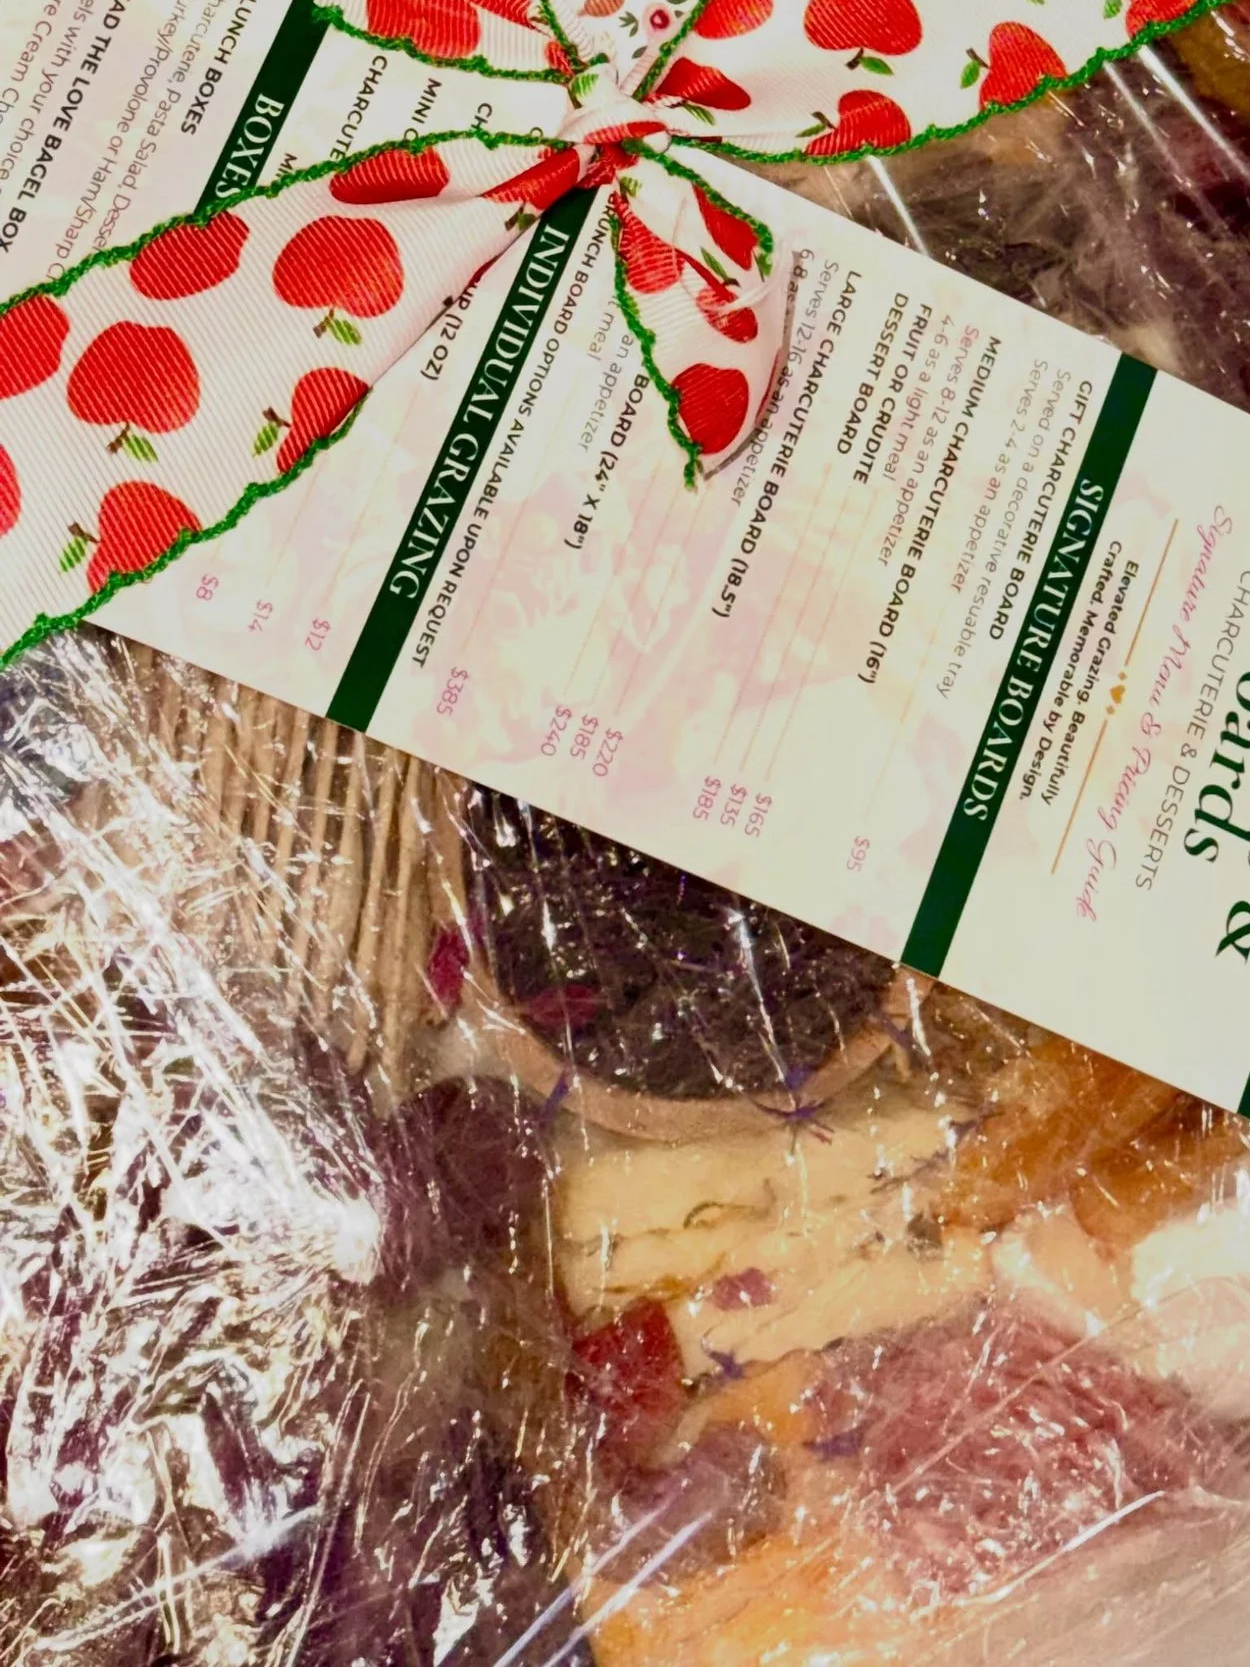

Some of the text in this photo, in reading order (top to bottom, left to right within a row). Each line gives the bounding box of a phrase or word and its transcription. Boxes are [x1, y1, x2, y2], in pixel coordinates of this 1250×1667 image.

[11, 20, 52, 82] Cream
[50, 26, 80, 67] with
[80, 35, 111, 74] THE
[29, 68, 58, 114] your
[52, 76, 90, 131] LOVE
[146, 87, 181, 137] Pasta
[180, 67, 222, 134] BOXES
[327, 52, 389, 163] CHARCUTE
[411, 77, 442, 124] MINI
[0, 117, 35, 178] choice
[17, 133, 62, 199] BAGEL
[105, 133, 124, 157] or
[117, 138, 157, 190] Salad,
[216, 93, 283, 208] BOXES
[0, 206, 27, 253] BOX
[55, 156, 116, 259] Ham/Sharp
[419, 278, 478, 380] UP (12 OZ)
[553, 269, 589, 334] BOARD
[826, 270, 861, 335] LARGE
[587, 311, 614, 361] meal
[614, 332, 637, 359] an
[517, 337, 559, 416] OPTIONS
[723, 254, 840, 509] Serves 12-16 as an appetizer
[836, 292, 908, 454] DESSERT BOARD
[852, 303, 932, 484] FRUIT OR CRUDITE
[882, 313, 954, 481] 4-6 as a light meal
[961, 336, 1001, 418] MEDIUM
[389, 225, 568, 598] INDIVIDUAL GRAZING
[579, 362, 622, 451] appetizer
[610, 373, 652, 447] BOARD
[770, 338, 834, 477] CHARCUTERIE
[473, 418, 524, 519] AVAILABLE
[878, 324, 979, 566] Serves 8-12 as an appetizer
[950, 358, 1048, 593] Serves 2-4 as an appetizer
[581, 492, 601, 511] X
[740, 480, 779, 554] BOARD
[907, 421, 968, 559] CHARCUTERIE
[988, 380, 1093, 640] GIFT CHARCUTERIE BOARD
[448, 523, 481, 577] UPON
[935, 368, 1071, 699] Served on a decorative resuable tray
[194, 572, 220, 602] $8
[247, 599, 273, 632] $14
[878, 563, 916, 637] BOARD
[304, 617, 331, 651] $12
[412, 580, 457, 667] REQUEST
[964, 479, 1103, 820] SIGNATURE BOARDS
[435, 666, 469, 715] $385
[1019, 540, 1122, 800] Crafted. Memorable by Design.
[1040, 559, 1139, 805] Elevated Grazing. Beautifully
[539, 704, 573, 756] $240
[569, 714, 599, 759] $185
[1075, 505, 1232, 921] Signature Menu & Pricing Guide
[591, 727, 624, 777] $220
[1178, 740, 1198, 759] &
[692, 775, 721, 820] $185
[719, 783, 748, 826] $135
[743, 792, 772, 837] $165
[1135, 764, 1190, 890] DESSERTS
[845, 835, 870, 871] $95
